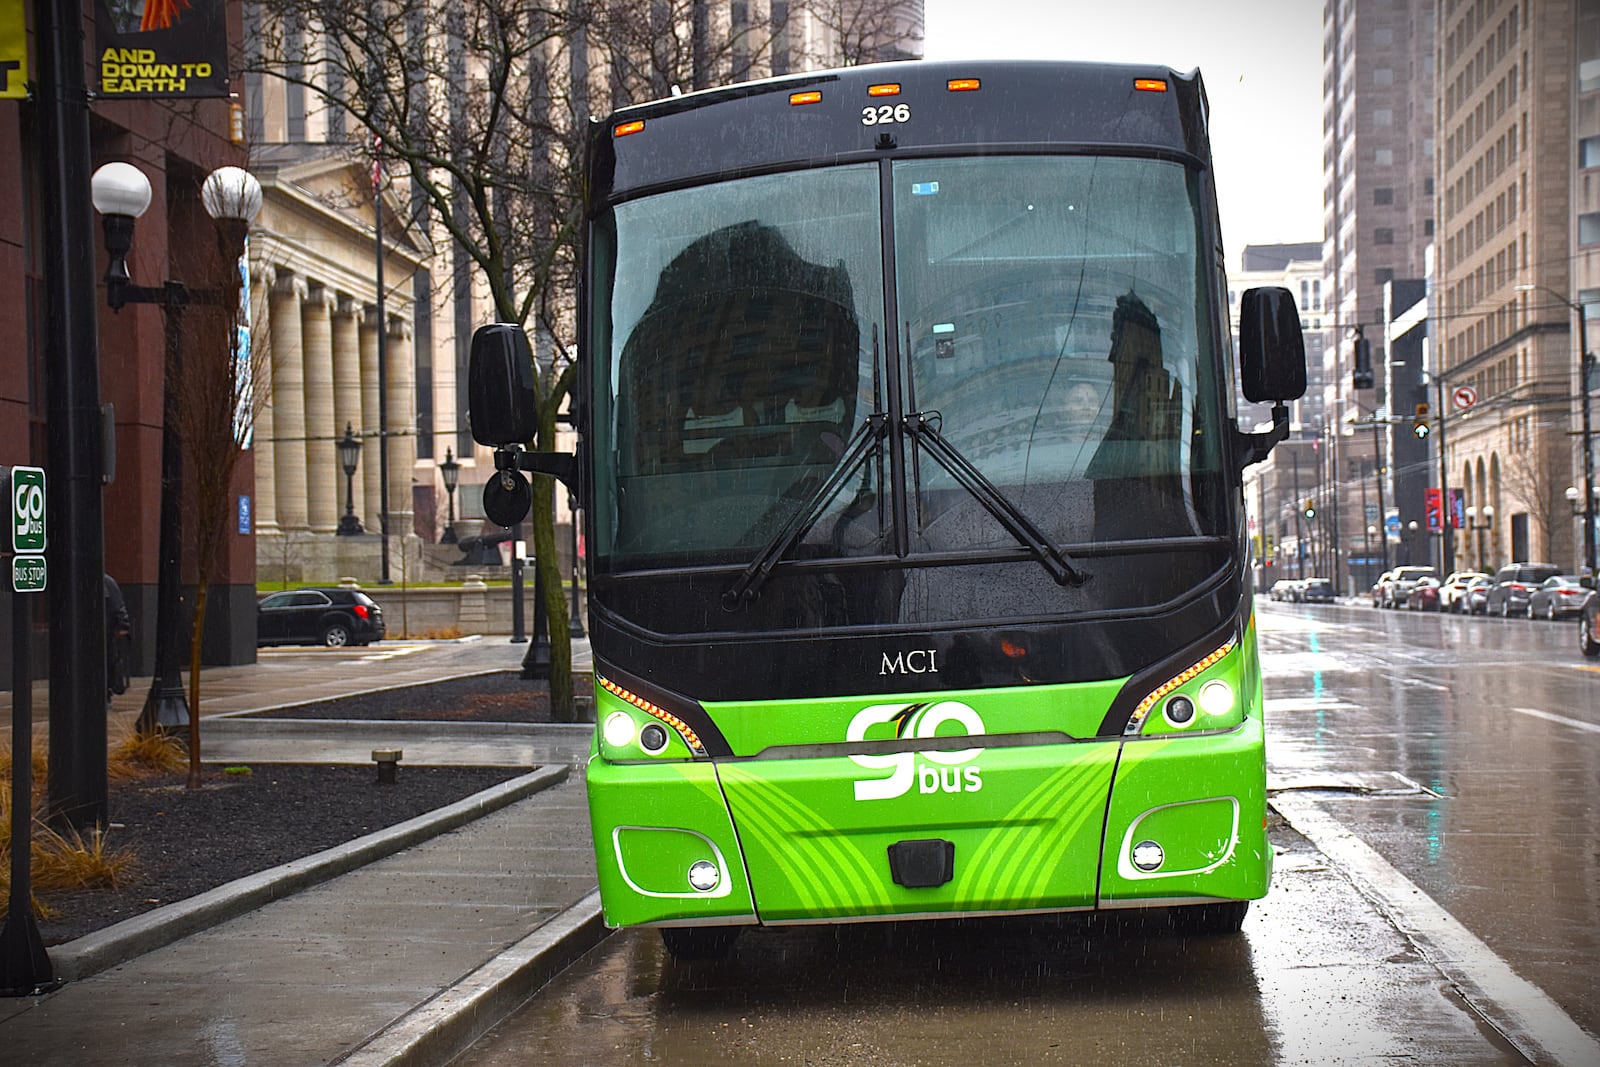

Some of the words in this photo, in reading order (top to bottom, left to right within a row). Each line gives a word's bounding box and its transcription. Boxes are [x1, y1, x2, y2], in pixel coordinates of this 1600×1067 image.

[102, 48, 156, 63] AND
[102, 63, 177, 78] DOWN
[182, 63, 212, 78] TO
[102, 78, 186, 93] EARTH
[862, 104, 911, 126] 326
[16, 484, 43, 534] go
[30, 520, 43, 534] bus
[15, 567, 27, 581] BUS
[28, 567, 45, 581] STOP
[879, 650, 938, 675] MCI
[846, 701, 986, 801] go
[919, 764, 982, 794] bus
